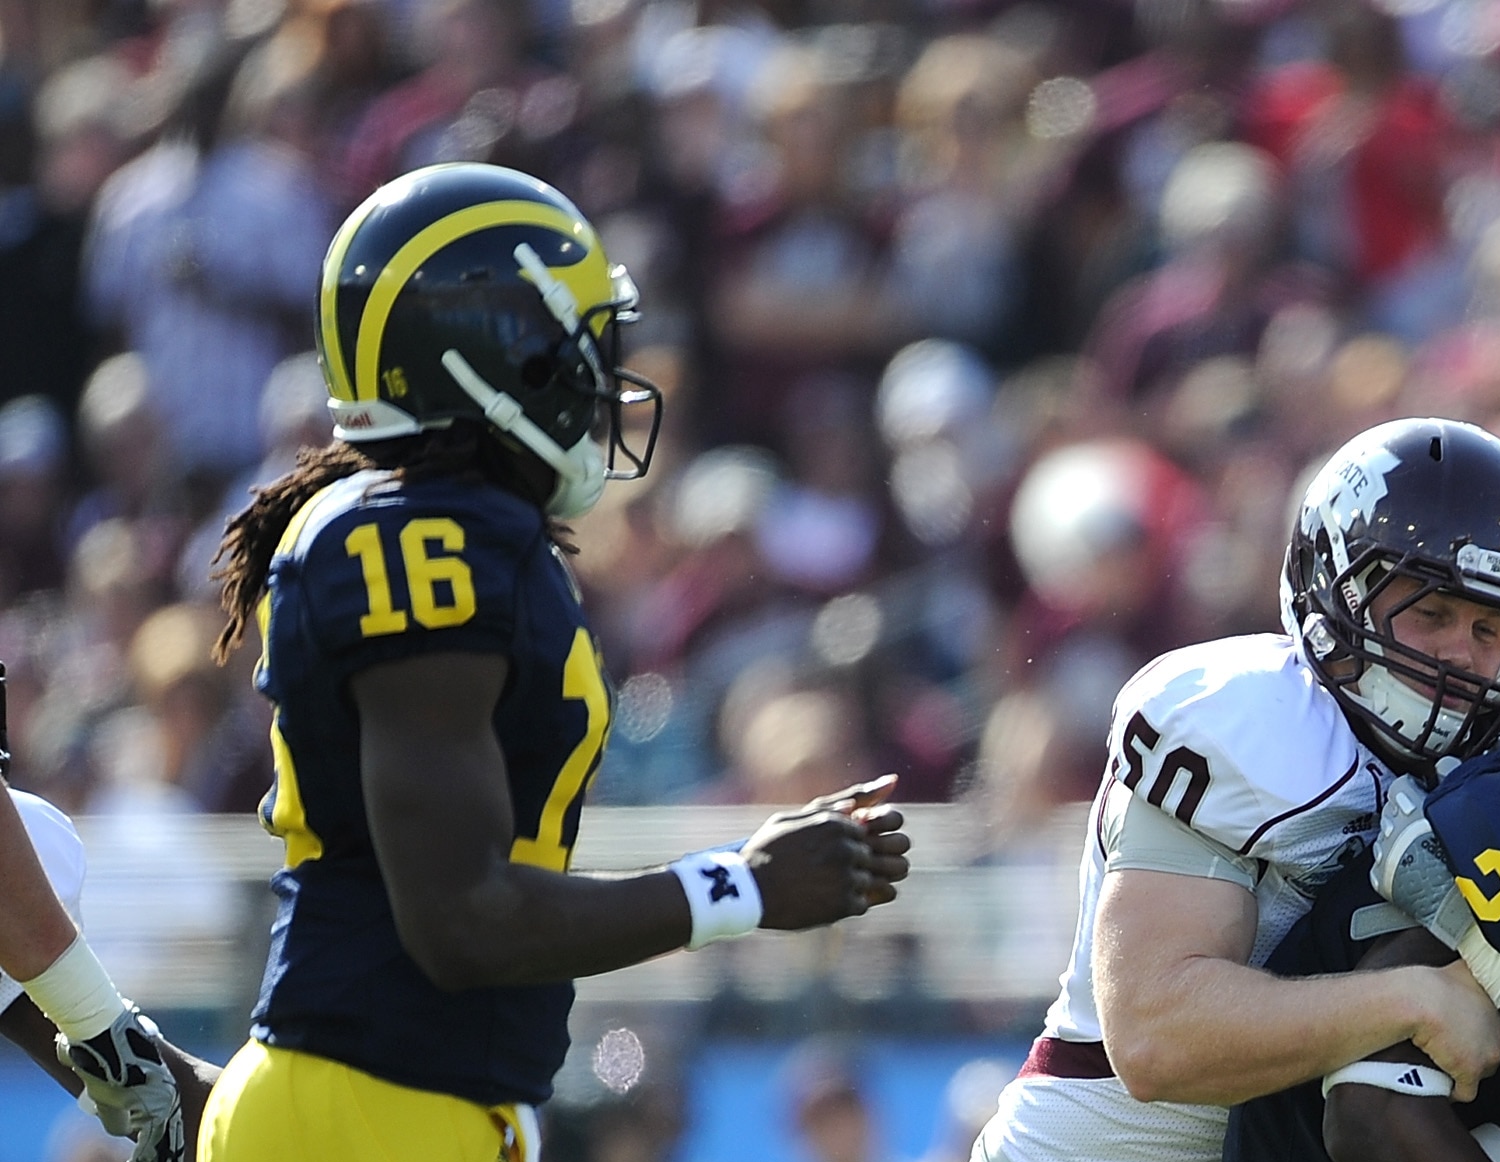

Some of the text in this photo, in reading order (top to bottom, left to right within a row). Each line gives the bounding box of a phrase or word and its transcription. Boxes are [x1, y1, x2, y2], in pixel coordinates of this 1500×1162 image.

[382, 367, 408, 398] 16
[345, 517, 477, 638] 16
[1122, 708, 1212, 827] 50
